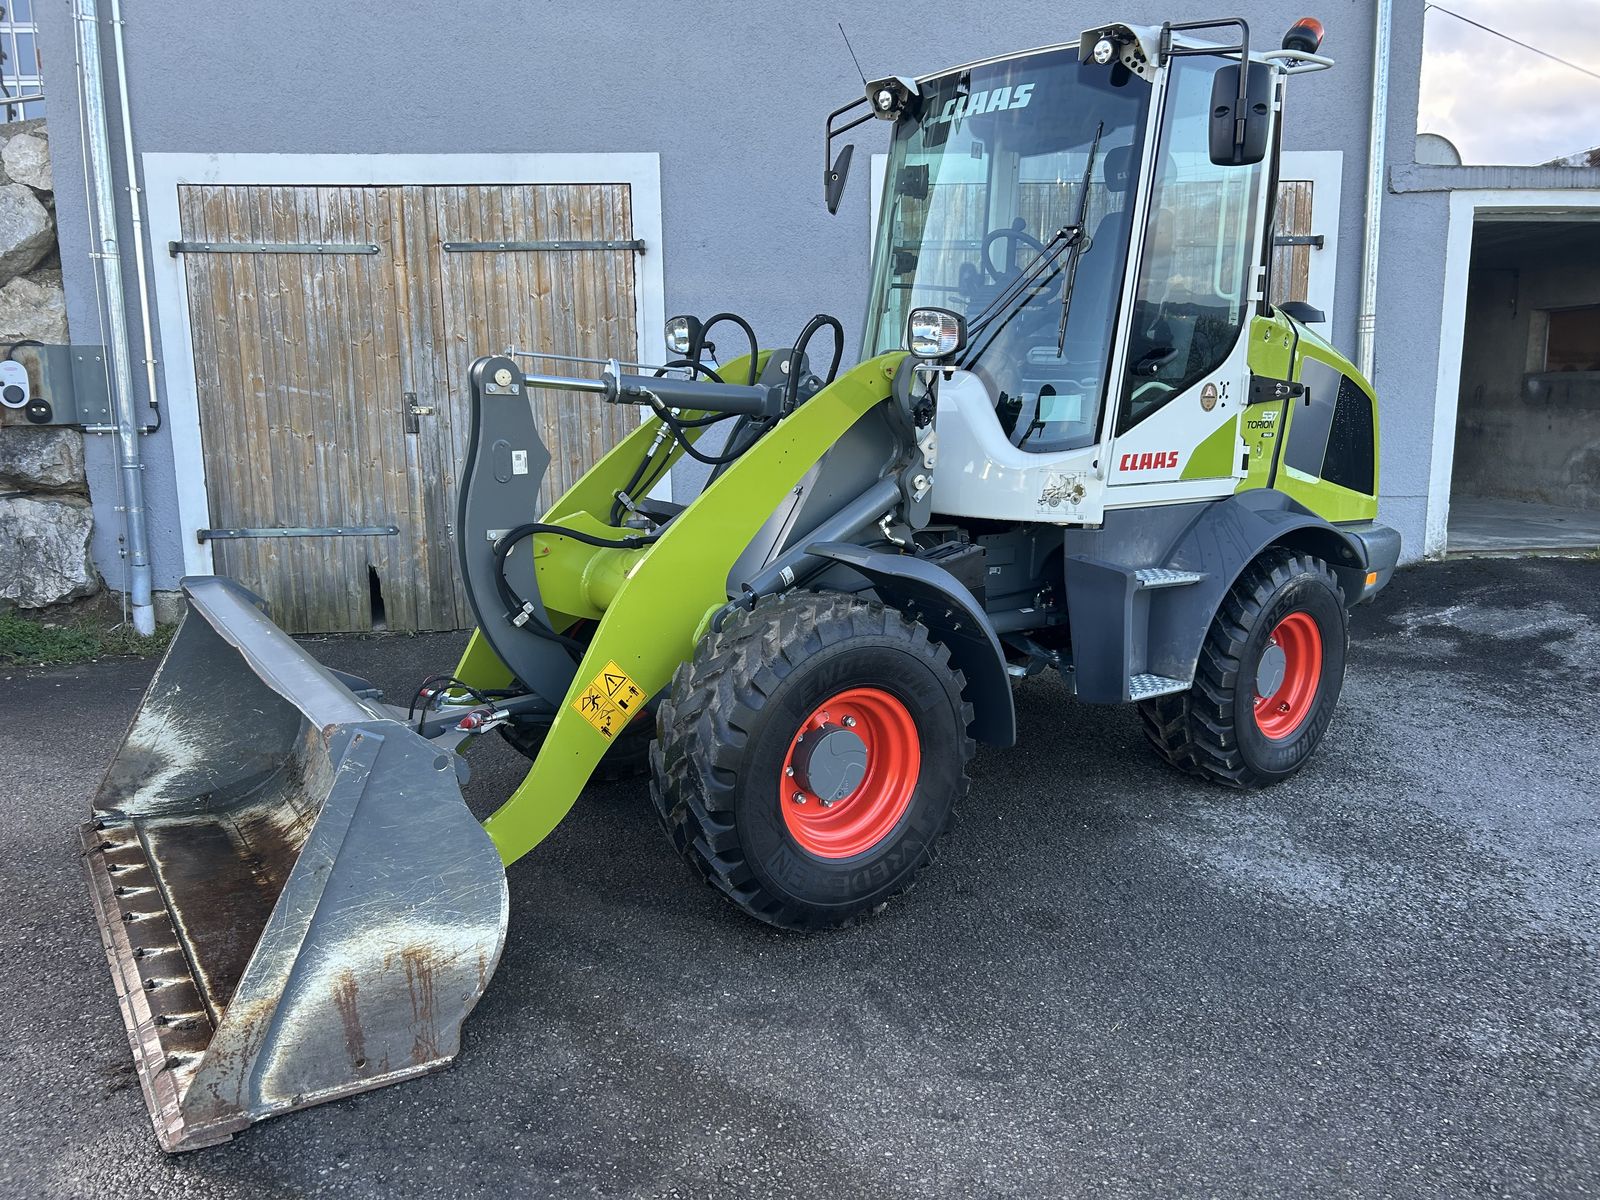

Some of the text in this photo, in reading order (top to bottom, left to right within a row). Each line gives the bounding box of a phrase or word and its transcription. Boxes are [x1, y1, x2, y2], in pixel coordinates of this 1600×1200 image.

[940, 83, 1035, 123] CLAAS
[1247, 420, 1274, 430] TORION
[1119, 451, 1178, 471] CLAAS
